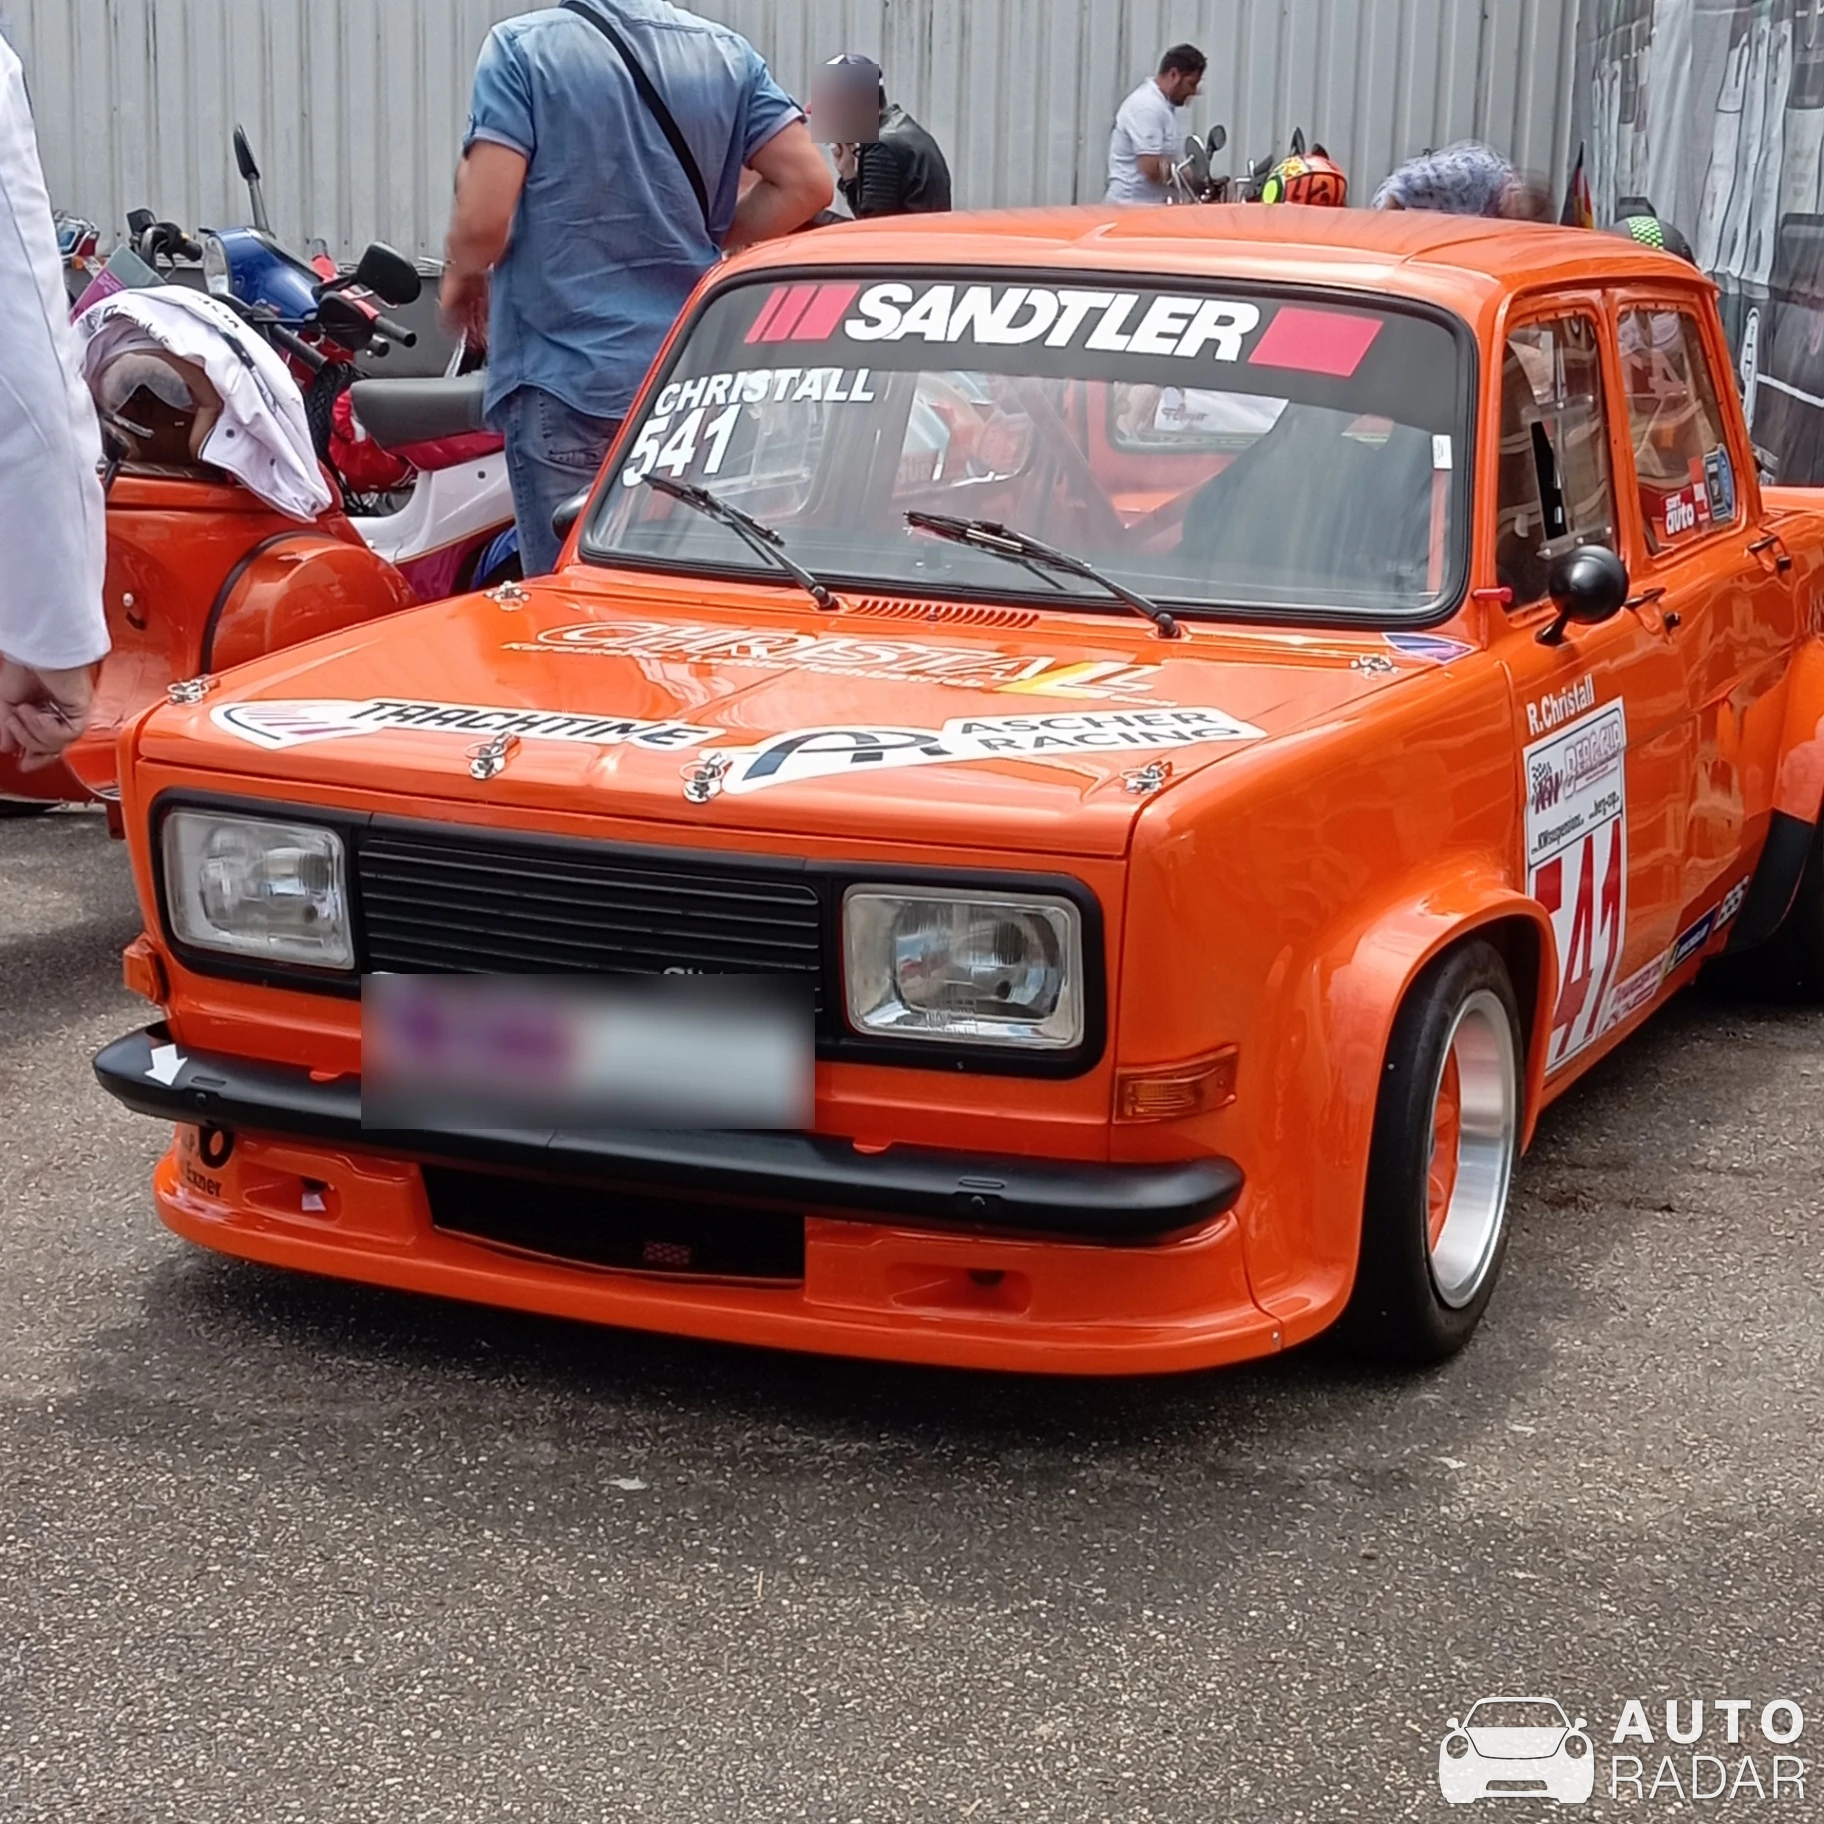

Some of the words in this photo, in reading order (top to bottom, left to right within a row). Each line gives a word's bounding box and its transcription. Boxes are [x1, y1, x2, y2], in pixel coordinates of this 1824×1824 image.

[844, 283, 1260, 362] SANDTLER
[654, 368, 875, 416] CHRISTALL
[622, 403, 743, 487] 541
[1666, 502, 1695, 535] auto
[537, 621, 1165, 699] CHRISTALL
[961, 711, 1222, 734] ASCHER
